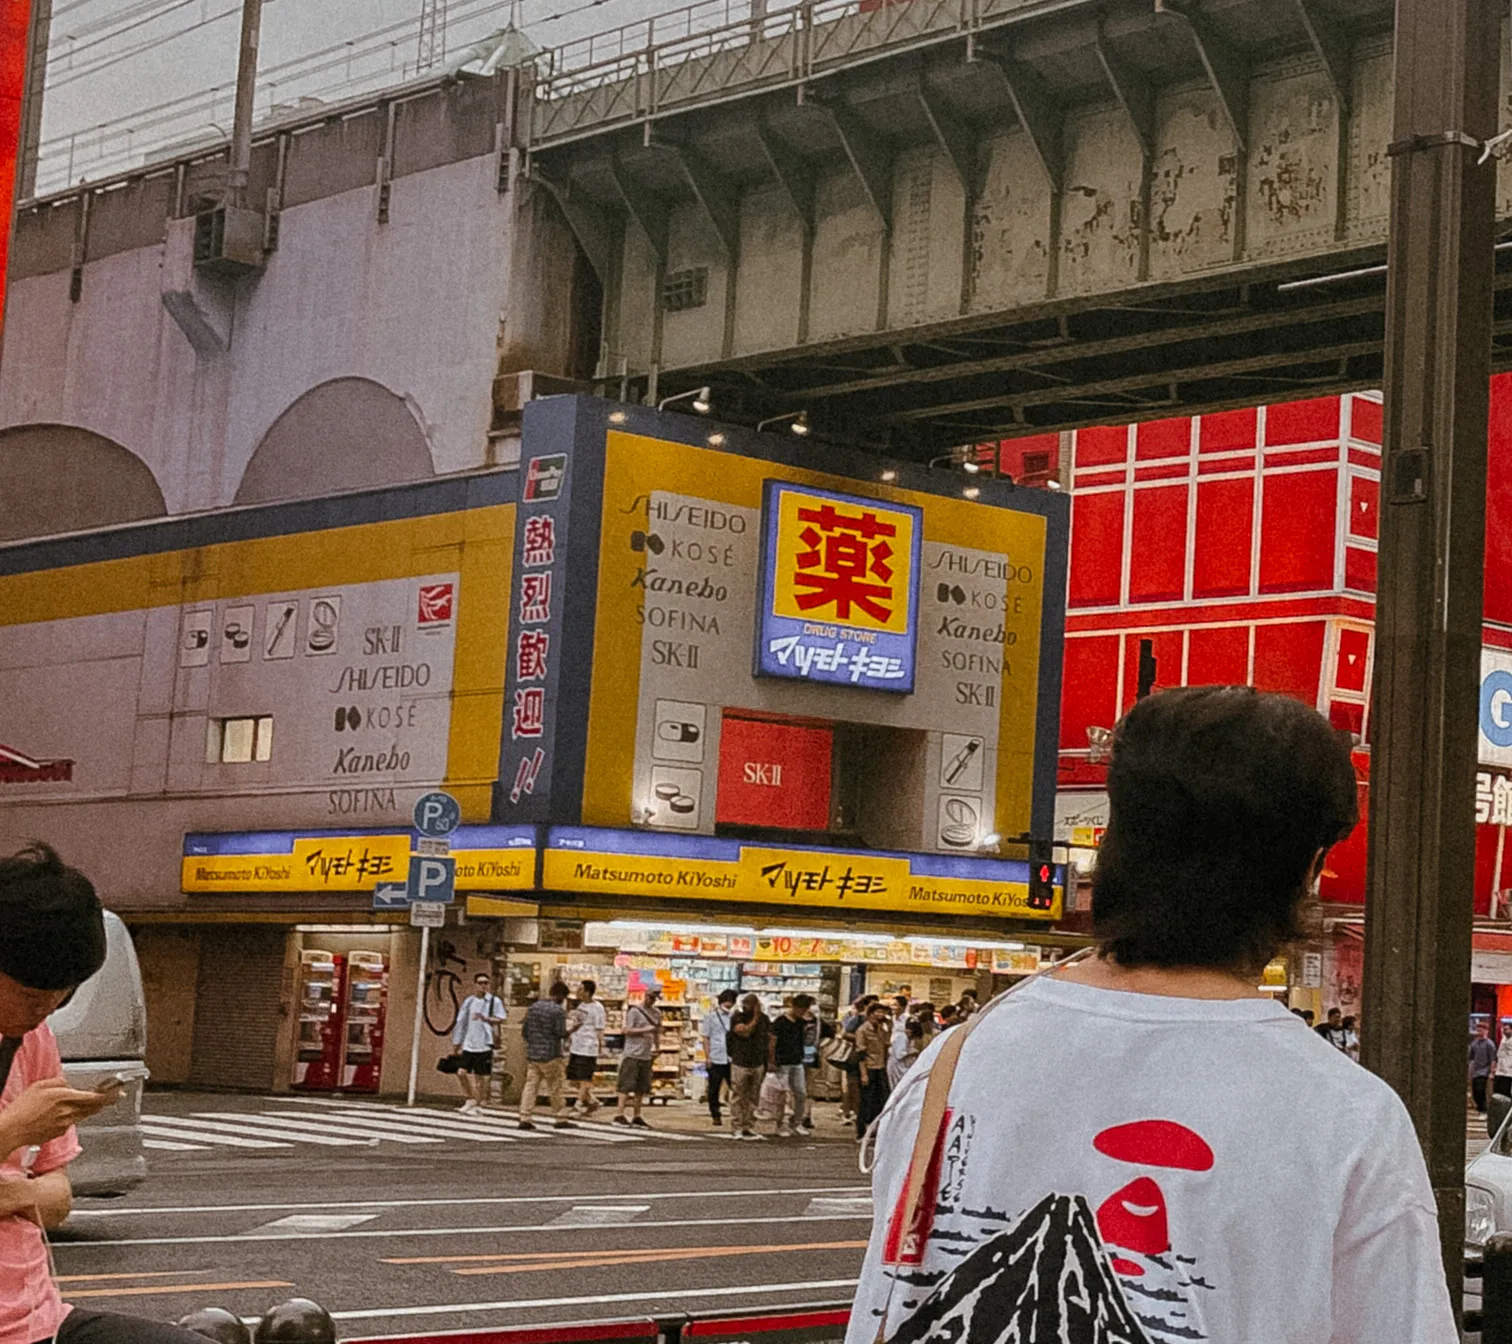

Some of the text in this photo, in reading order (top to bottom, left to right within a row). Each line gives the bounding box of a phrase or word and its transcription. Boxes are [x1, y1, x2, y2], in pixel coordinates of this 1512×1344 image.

[619, 495, 746, 534] SHISEIDO
[672, 539, 735, 567] KOSÉ
[793, 504, 896, 624] 薬
[930, 551, 1032, 584] SHISEIDO
[631, 568, 728, 602] Kanebo
[635, 605, 720, 636] SOFINA
[803, 622, 838, 638] DRUG
[937, 616, 1018, 646] Kanebo
[363, 626, 401, 656] SK-II
[652, 639, 700, 669] SK-II
[941, 650, 1012, 676] SOFINA
[329, 663, 431, 693] SHISEIDO
[955, 682, 996, 707] SK-II
[333, 745, 411, 774] Kanebo
[743, 761, 782, 786] SK-II
[329, 788, 397, 815] SOFINA
[422, 802, 443, 830] P
[418, 860, 447, 897] P
[574, 864, 738, 889] Matsumoto KiYoshi
[908, 886, 1028, 908] Matsumoto KiYos
